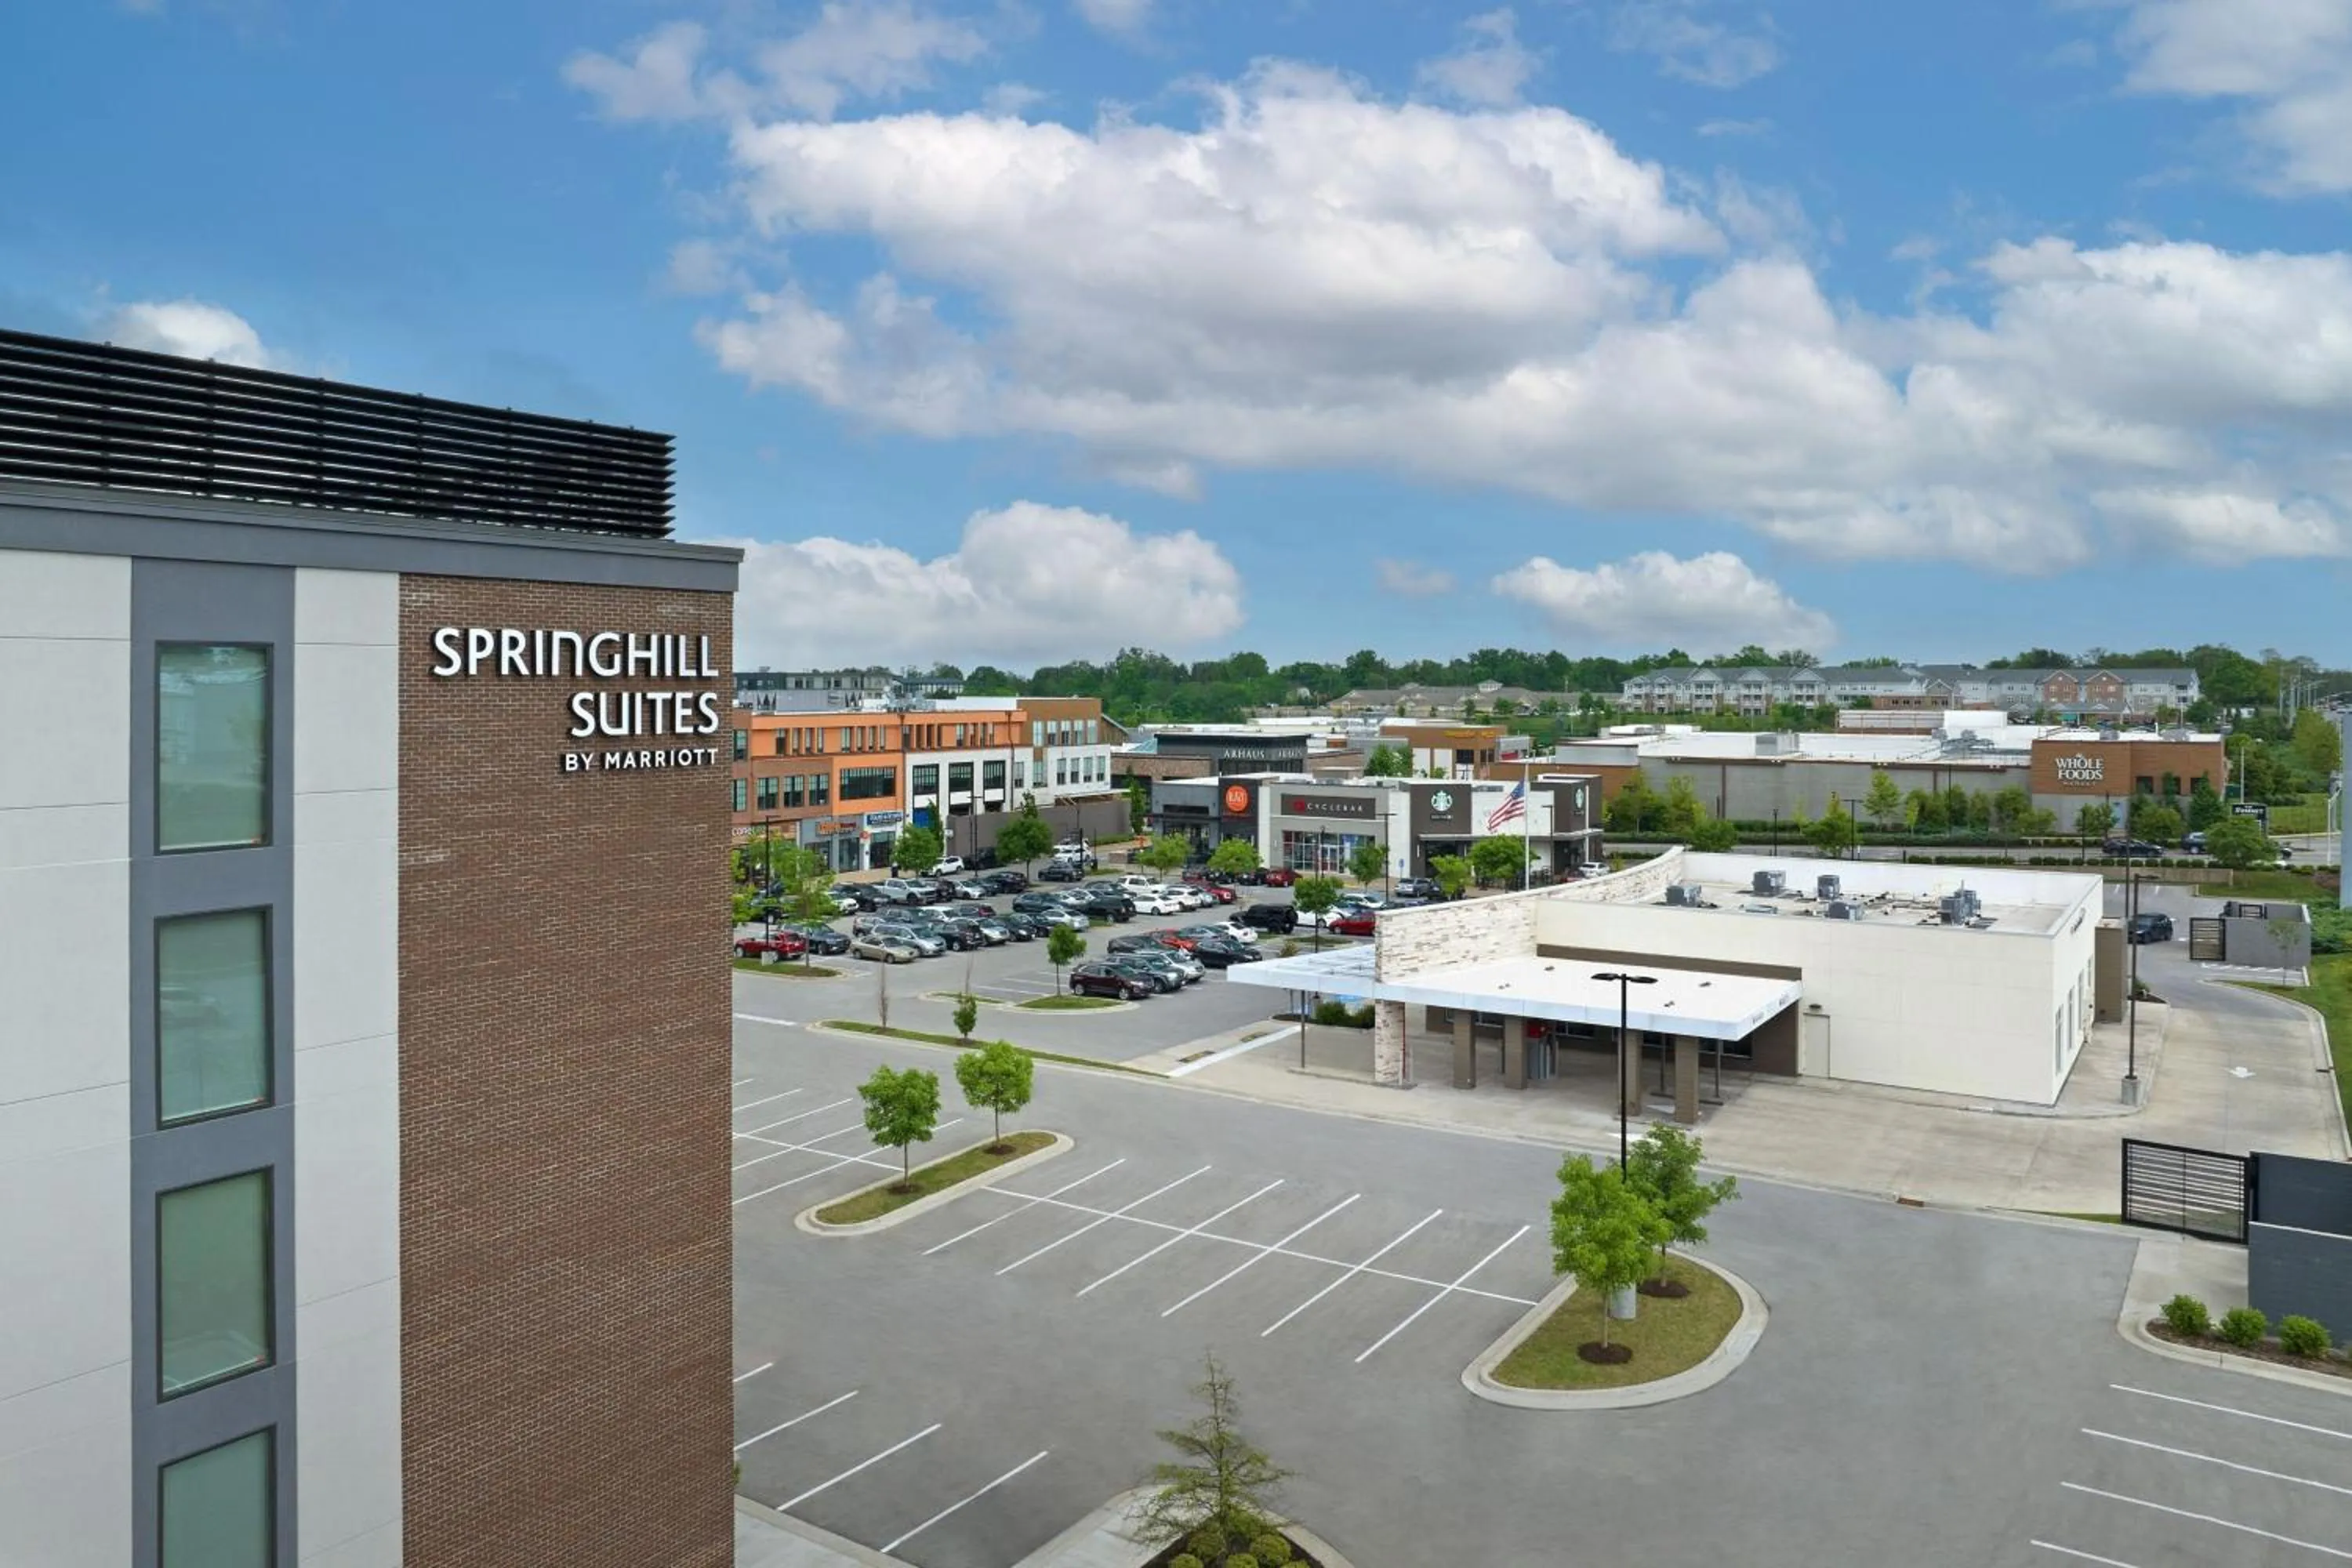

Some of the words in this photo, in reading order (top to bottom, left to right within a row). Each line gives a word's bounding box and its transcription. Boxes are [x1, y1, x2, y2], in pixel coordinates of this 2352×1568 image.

[432, 627, 719, 677] SPRINGHILL
[571, 691, 719, 738] SUITES
[565, 753, 593, 771] BY
[604, 749, 718, 769] MARRIOTT
[2055, 757, 2104, 768] WHOLE
[2058, 769, 2103, 780] FOODS
